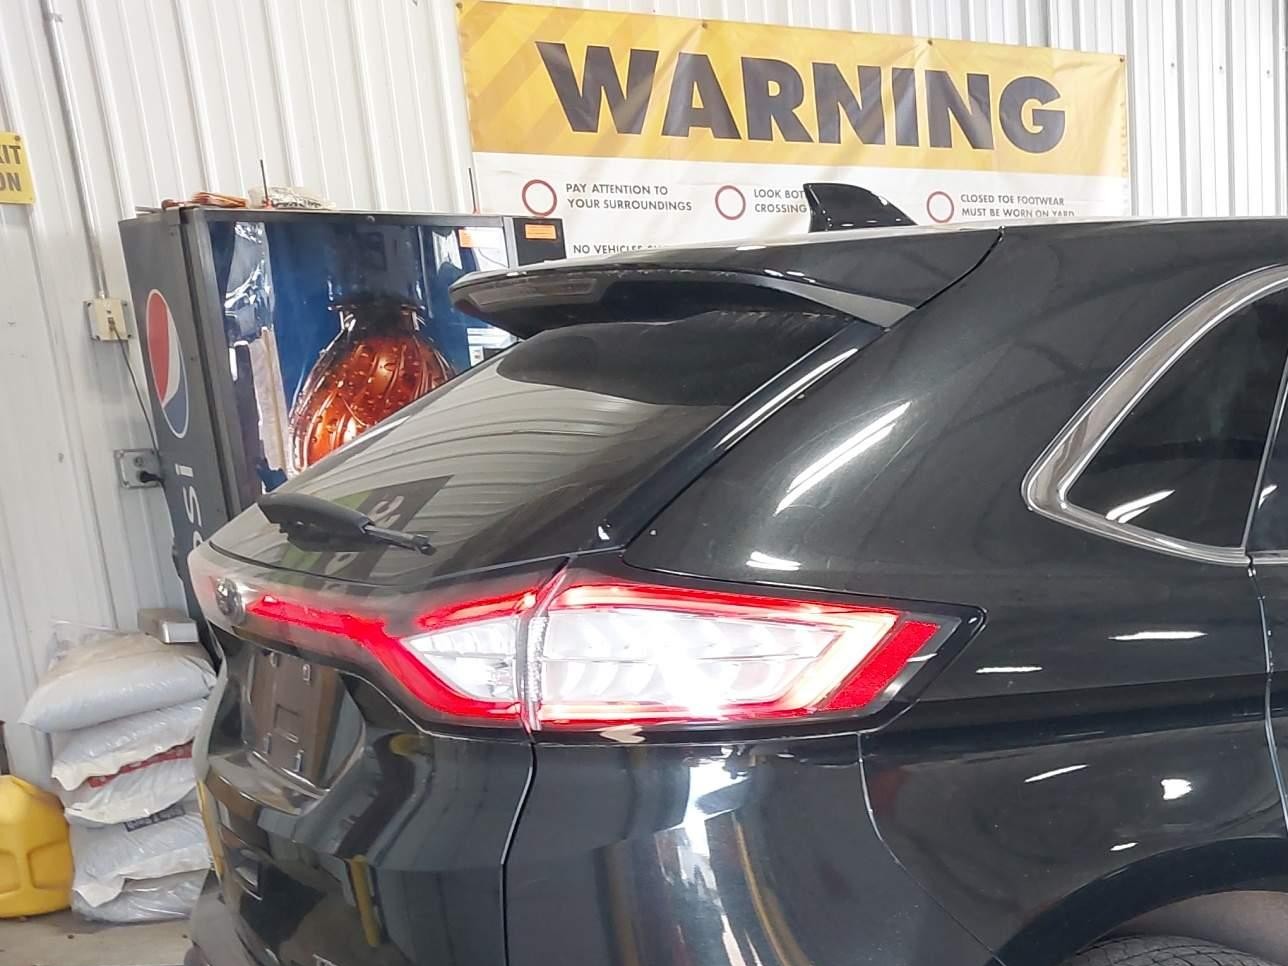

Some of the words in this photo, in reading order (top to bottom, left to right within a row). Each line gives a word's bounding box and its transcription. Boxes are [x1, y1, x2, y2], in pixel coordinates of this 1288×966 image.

[535, 41, 1066, 154] WARNING
[0, 144, 21, 165] IT
[566, 183, 587, 193] PAY
[592, 184, 650, 195] ATTENTION
[655, 186, 668, 195] TO
[754, 188, 782, 199] LOOK
[568, 198, 600, 209] YOUR
[603, 199, 693, 211] SURROUNDINGS
[960, 193, 995, 203] CLOSED
[998, 195, 1015, 204] TOE
[1017, 195, 1064, 206] FOOTWEAR
[755, 203, 807, 213] CROSSING
[961, 208, 986, 217] MUST
[990, 208, 1000, 217] BE
[1002, 209, 1033, 218] WORN
[1035, 209, 1049, 218] ON
[573, 244, 590, 254] NO
